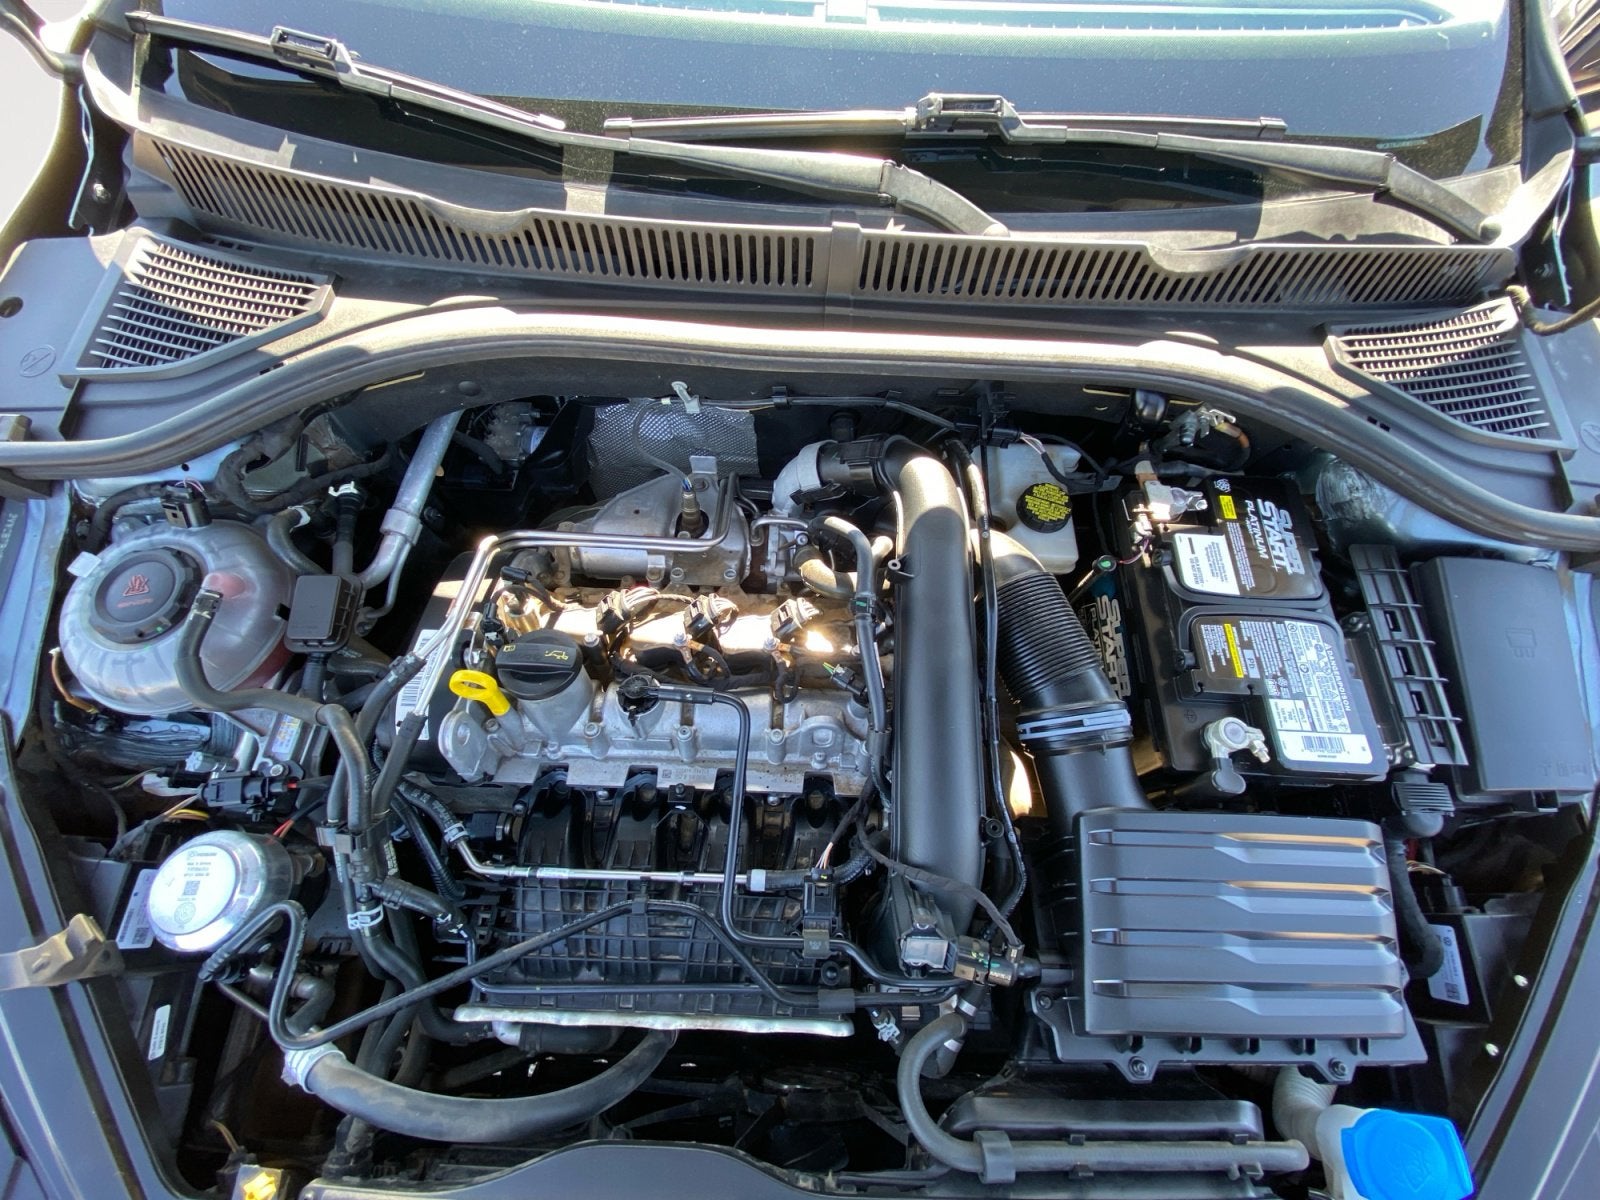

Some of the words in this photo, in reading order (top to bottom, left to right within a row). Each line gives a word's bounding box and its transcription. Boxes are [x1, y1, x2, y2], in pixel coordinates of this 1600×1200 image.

[1245, 499, 1268, 559] PLATINUM
[1258, 499, 1291, 574] START
[1275, 509, 1305, 575] SUPER
[1099, 594, 1122, 699] START
[1110, 598, 1131, 697] SUPER
[1246, 656, 1257, 669] Pb
